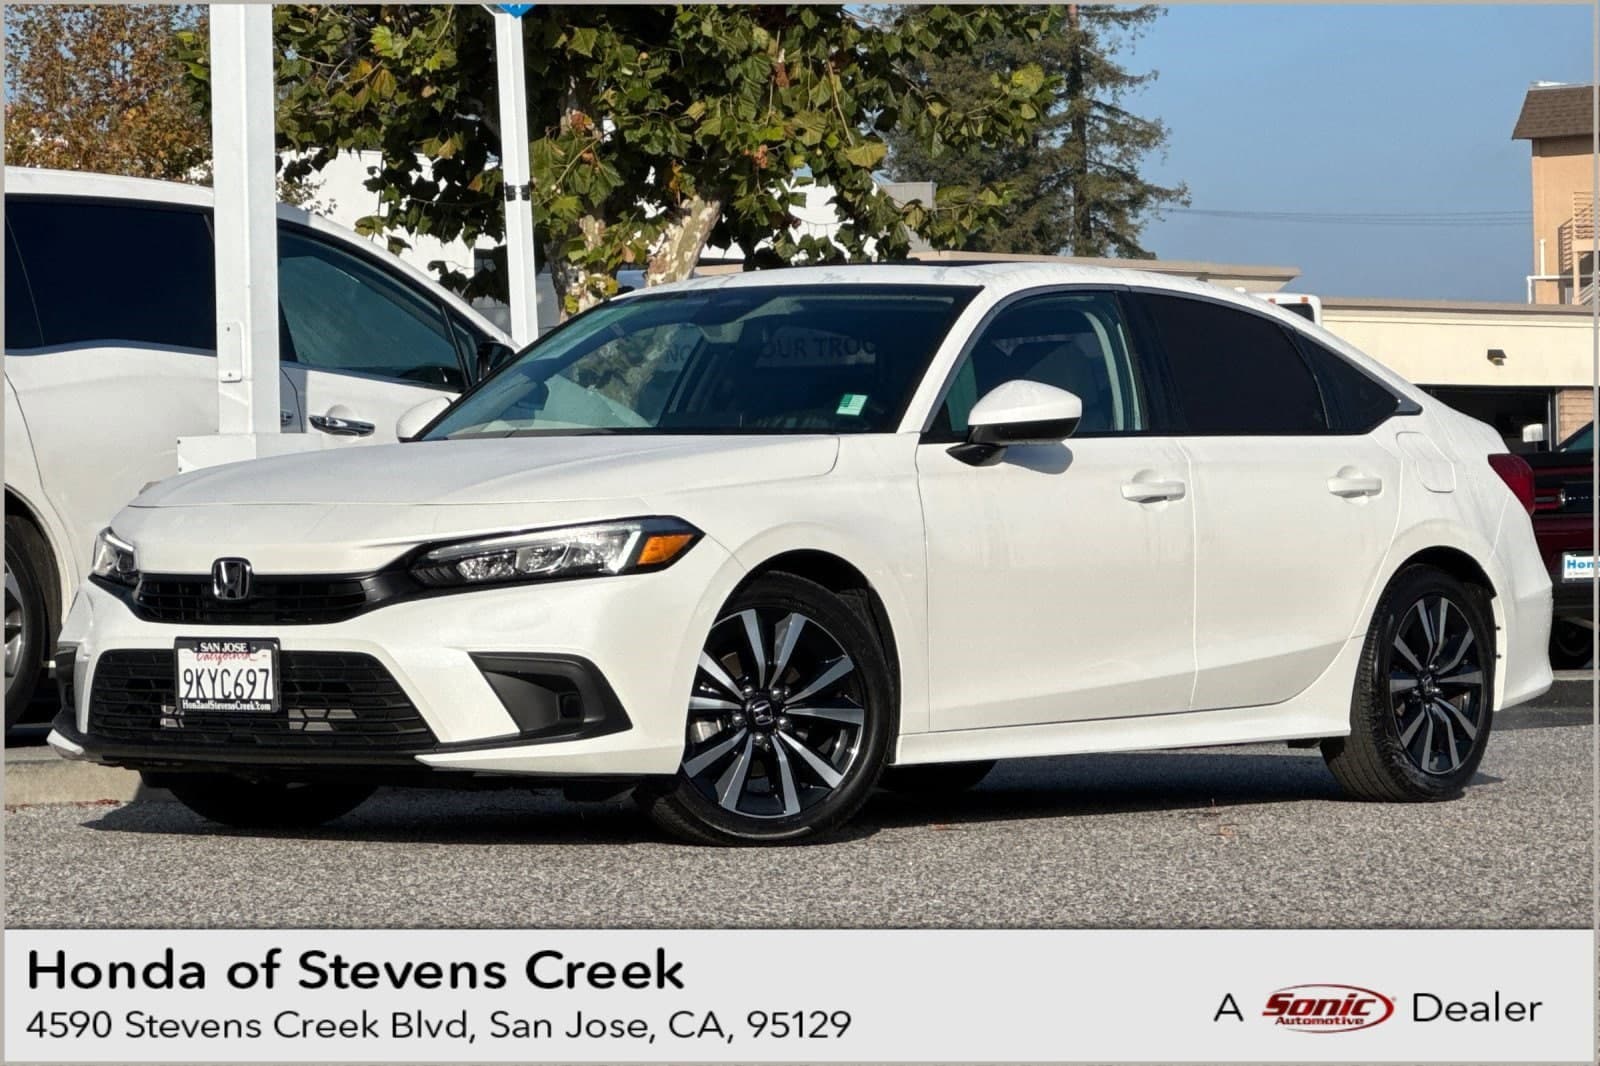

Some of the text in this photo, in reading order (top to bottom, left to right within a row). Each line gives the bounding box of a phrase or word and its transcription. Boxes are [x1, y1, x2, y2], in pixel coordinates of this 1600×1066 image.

[200, 642, 248, 652] SAN JOSE
[183, 668, 270, 700] 9KYC697
